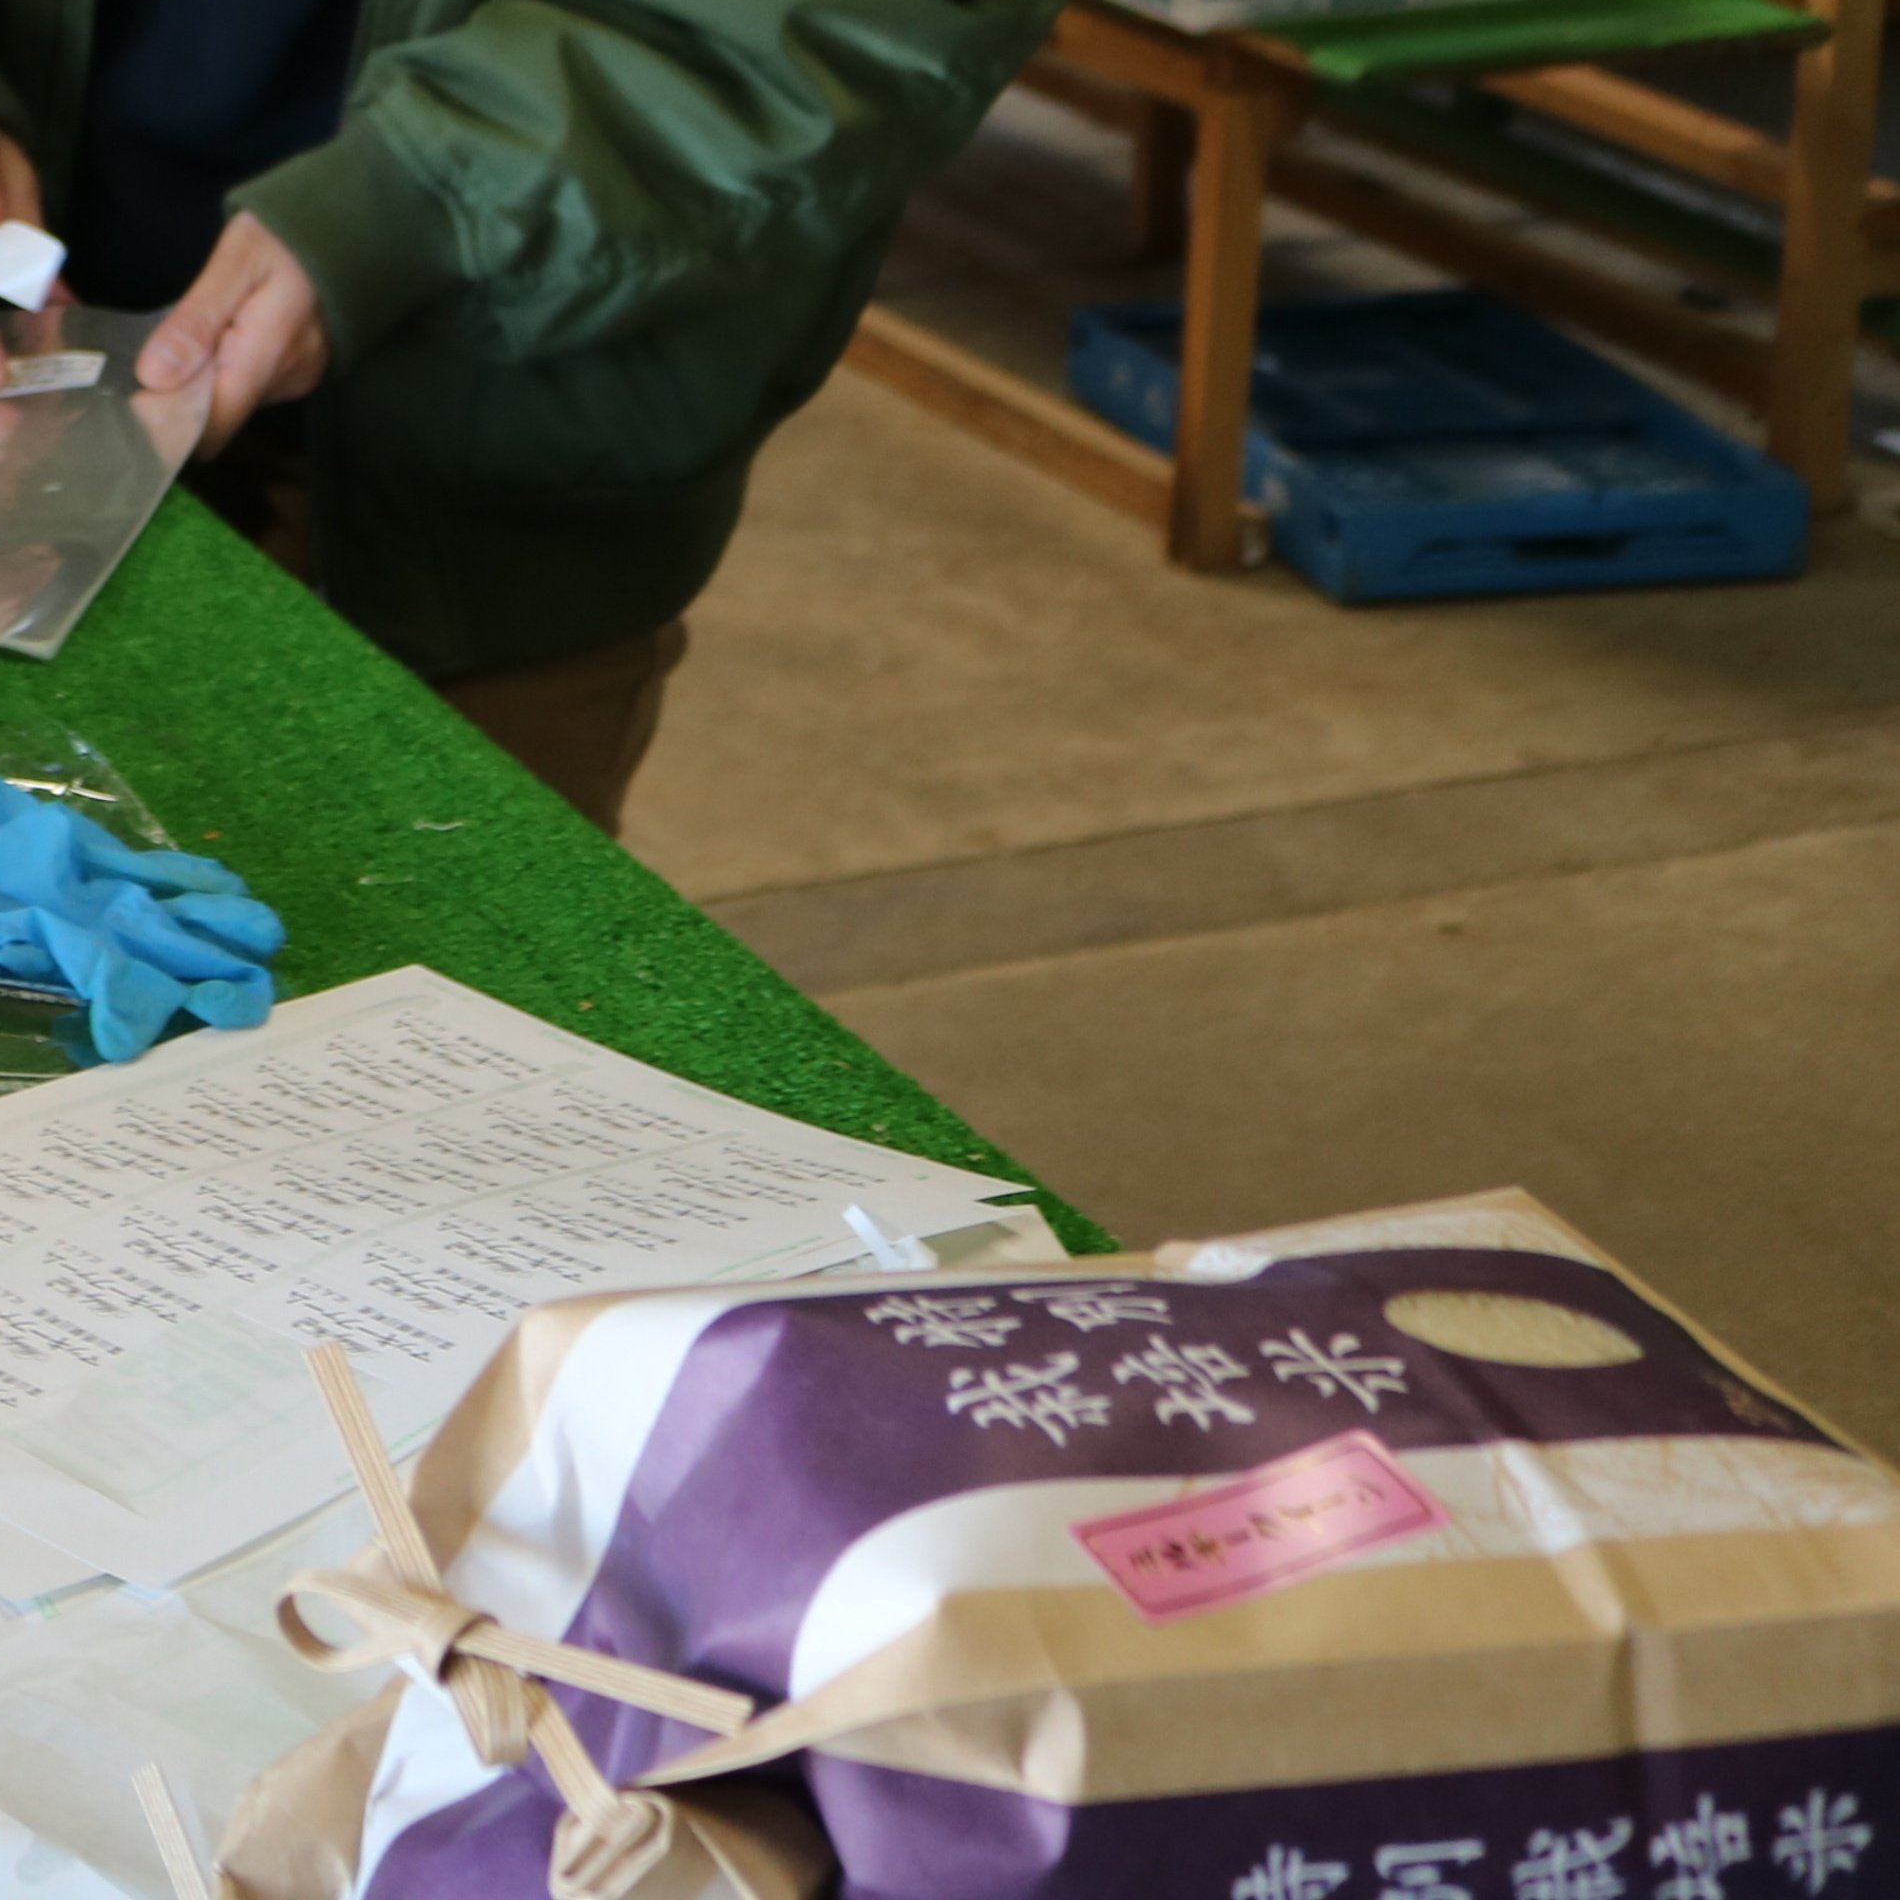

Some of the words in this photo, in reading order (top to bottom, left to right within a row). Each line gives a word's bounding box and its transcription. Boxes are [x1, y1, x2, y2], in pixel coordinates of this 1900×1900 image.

[114, 1105, 239, 1158] マッキーファーム
[186, 1083, 312, 1138] マッキーファーム
[41, 1128, 166, 1180] マッキーファーム
[200, 1187, 332, 1245] マッキーファーム
[271, 1166, 407, 1214] マッキーファーム
[585, 1180, 727, 1227] マッキーファーム
[120, 1218, 256, 1282] マッキーファーム
[439, 1222, 583, 1282] マッキーファーム
[513, 1200, 656, 1251] マッキーファーム
[44, 1251, 179, 1323] マッキーファーム
[363, 1253, 508, 1320] マッキーファーム
[864, 1283, 1173, 1348] 特別
[287, 1291, 432, 1362] マッキーファーム
[944, 1327, 1408, 1447] 栽培米
